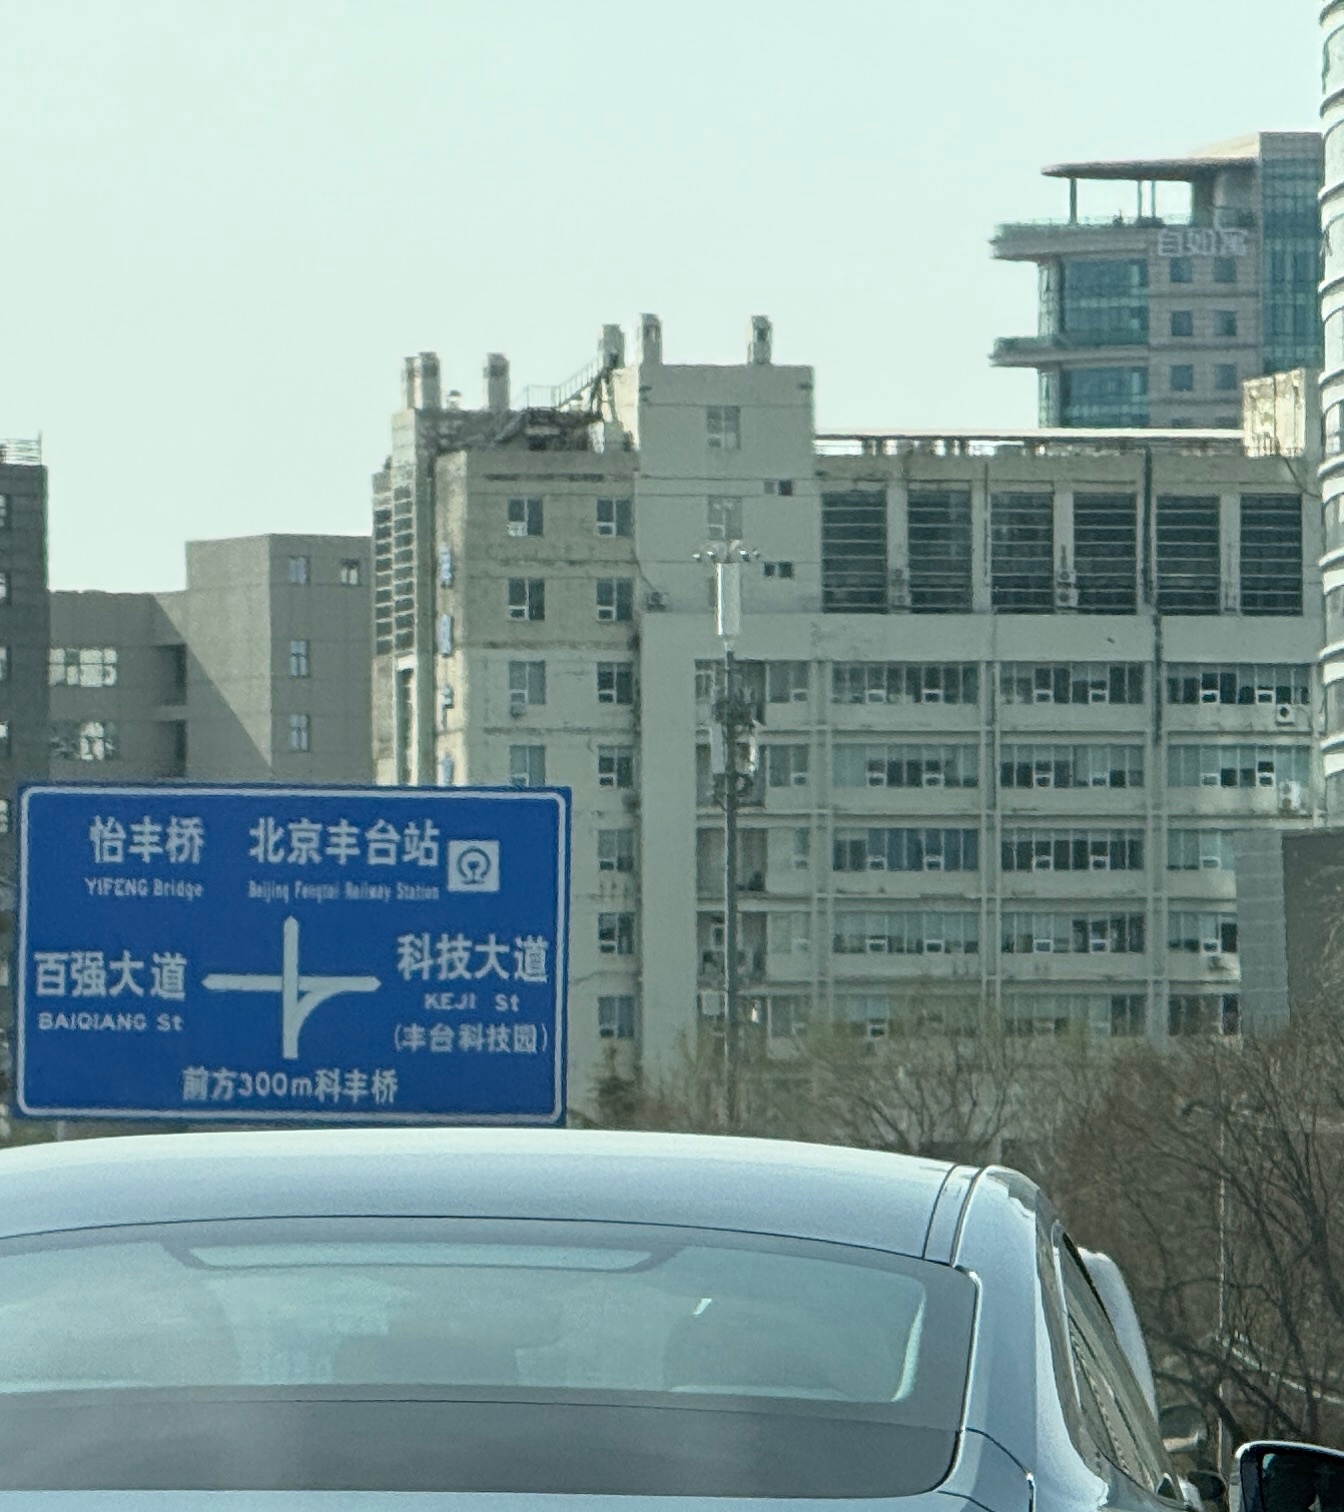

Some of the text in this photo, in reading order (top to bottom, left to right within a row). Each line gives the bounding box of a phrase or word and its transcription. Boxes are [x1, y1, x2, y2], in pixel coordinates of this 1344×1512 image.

[90, 816, 206, 865] 怡丰桥
[249, 817, 441, 867] 北京丰台站
[84, 878, 205, 900] YIFENG Bridge
[248, 880, 290, 903] Beijing
[345, 881, 392, 902] Railway
[396, 881, 441, 900] Station
[34, 950, 189, 1001] 百强大道
[397, 933, 550, 984] 科技大道
[425, 993, 521, 1014] KEJI St
[38, 1012, 184, 1033] BAIQIANG St
[394, 1023, 549, 1055] (丰台科技园)
[182, 1066, 400, 1105] 前方300m科丰桥
